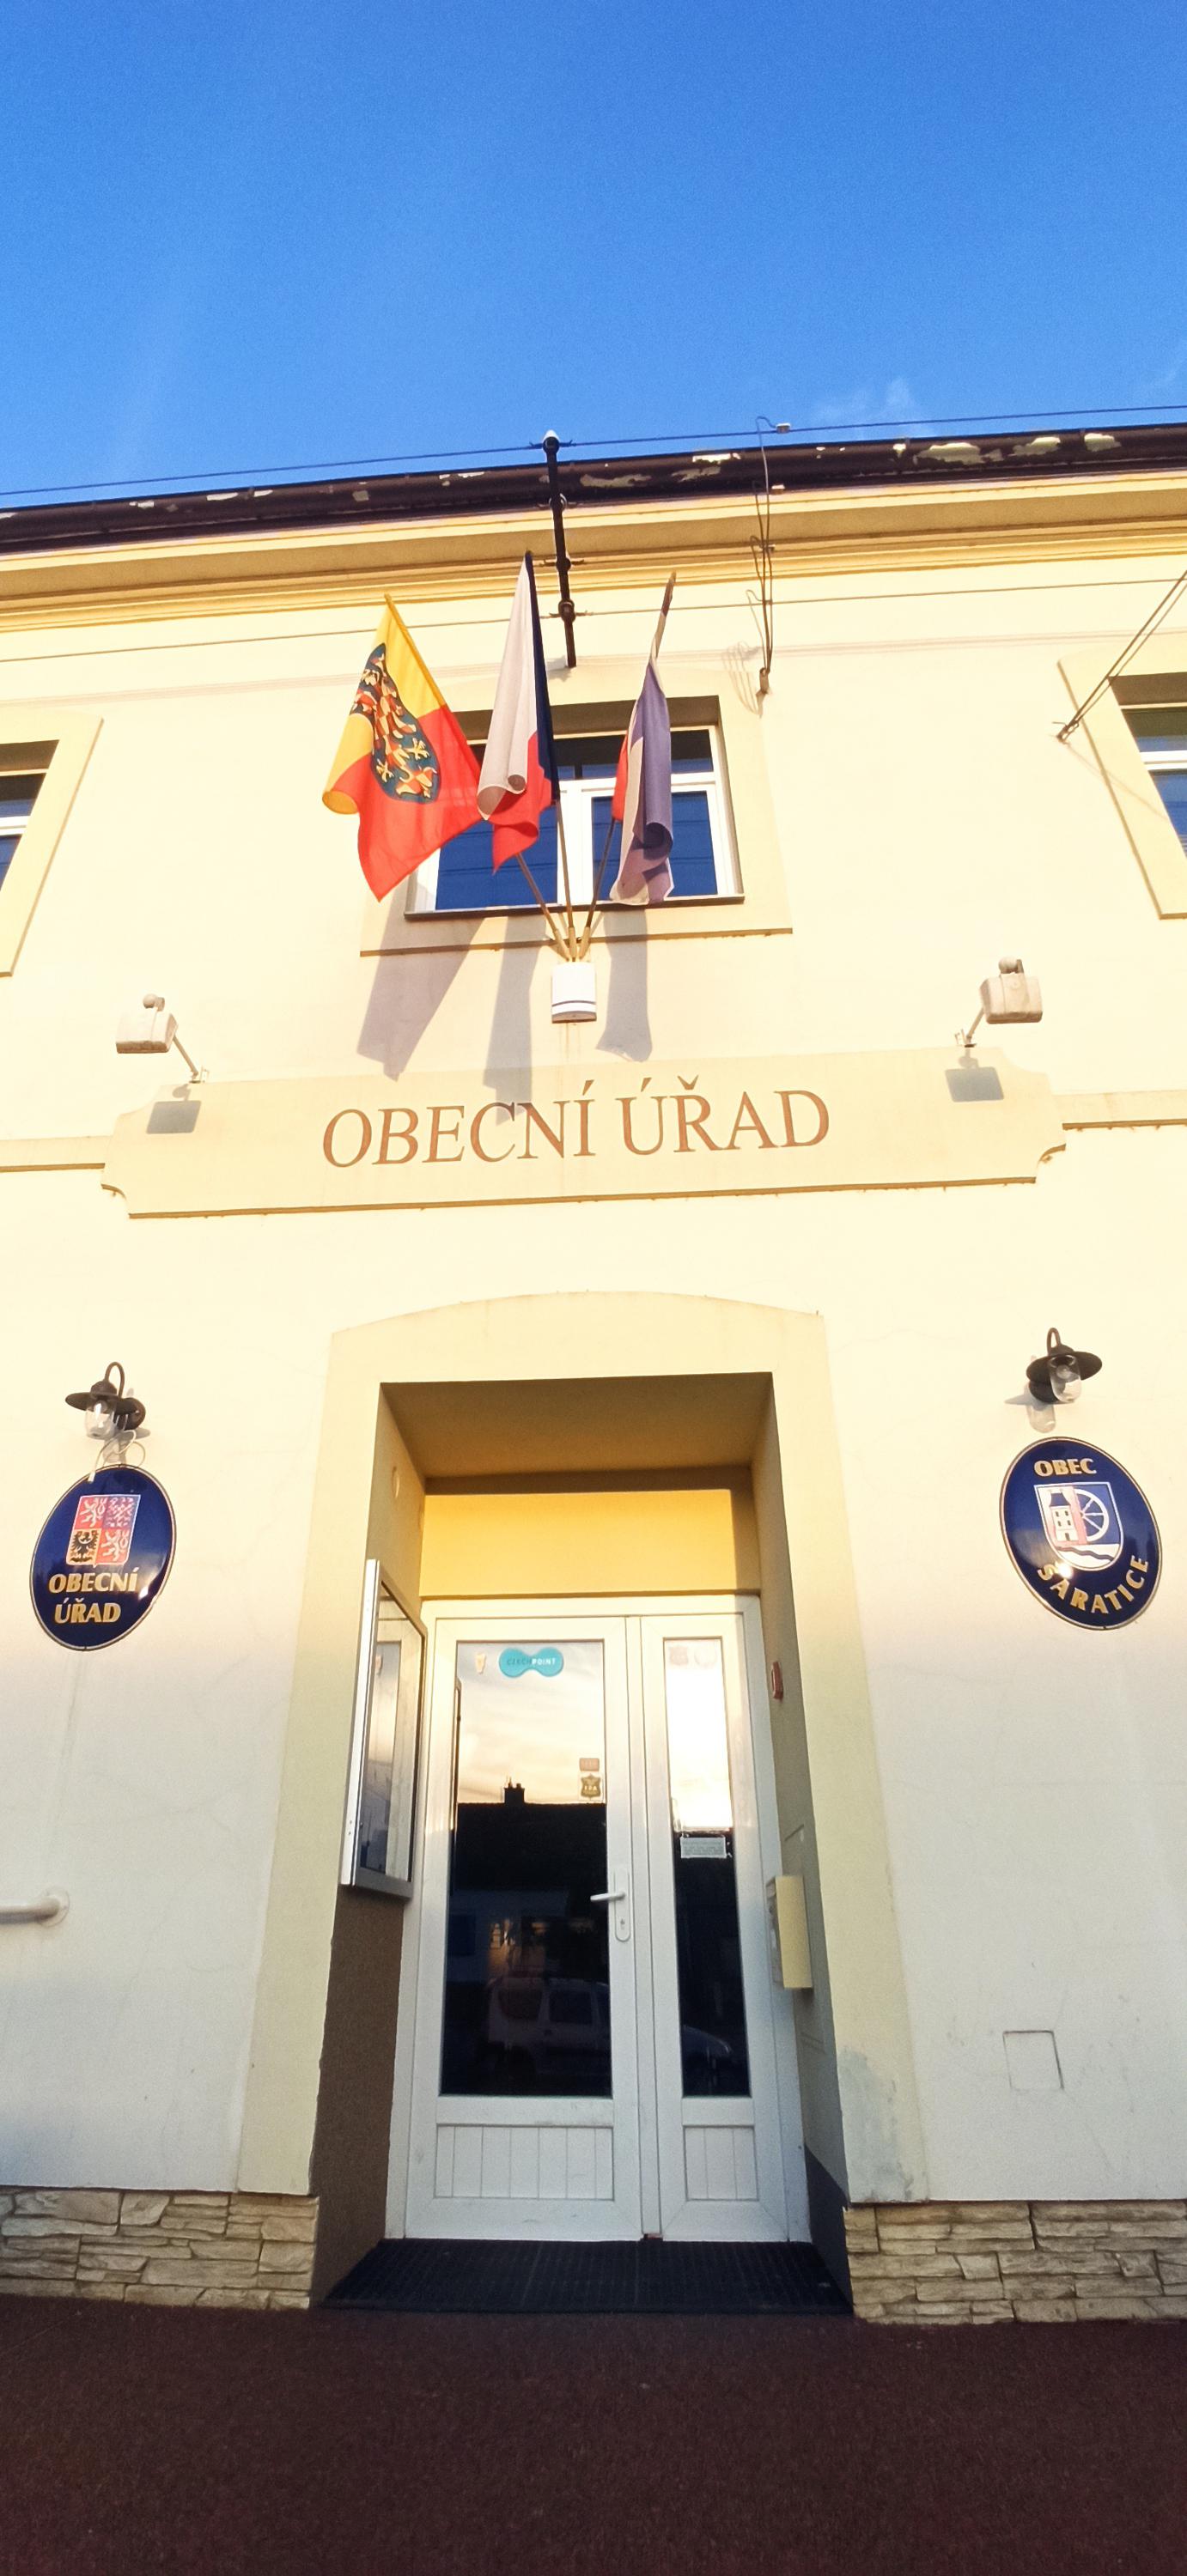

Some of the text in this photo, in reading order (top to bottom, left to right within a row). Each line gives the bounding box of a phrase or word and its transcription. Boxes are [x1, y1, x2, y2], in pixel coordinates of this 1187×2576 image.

[322, 1075, 830, 1168] OBECNÍ ÚŘAD
[1033, 1458, 1098, 1477] OBEC
[48, 1567, 139, 1594] OBECNÍ
[54, 1597, 121, 1624] ÚŘAD
